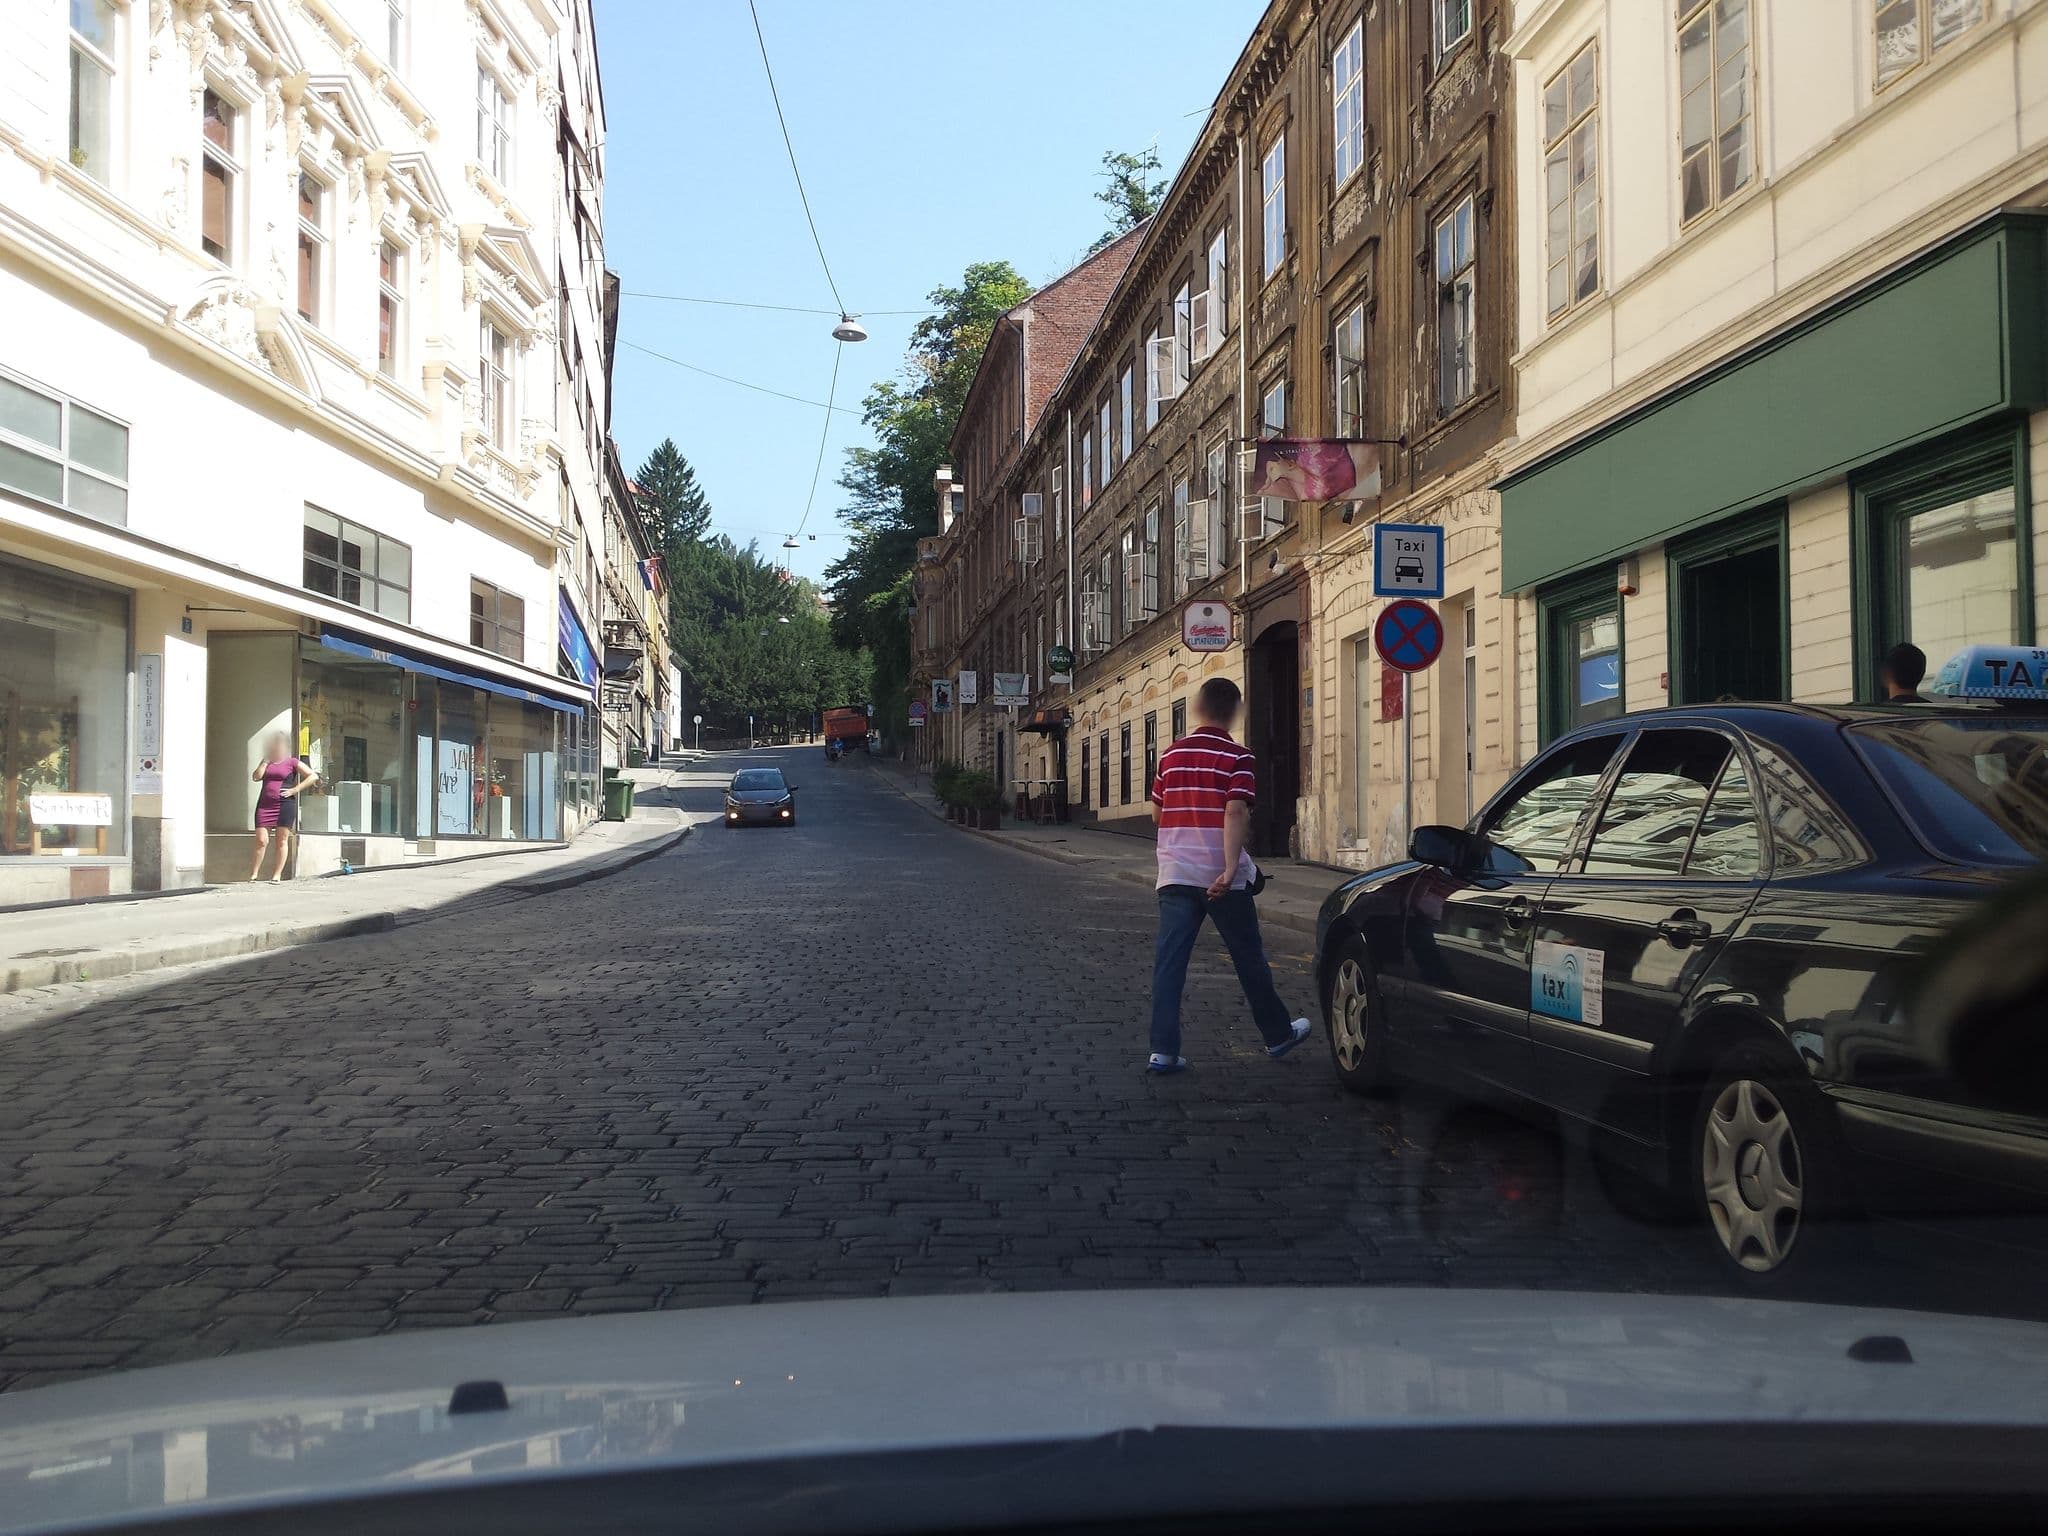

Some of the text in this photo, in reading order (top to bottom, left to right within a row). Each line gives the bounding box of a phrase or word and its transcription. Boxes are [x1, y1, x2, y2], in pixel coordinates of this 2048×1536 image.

[1394, 538, 1425, 552] Taxi
[1051, 655, 1070, 663] PAN
[2032, 650, 2048, 660] 39
[145, 663, 153, 727] SCULPTOR
